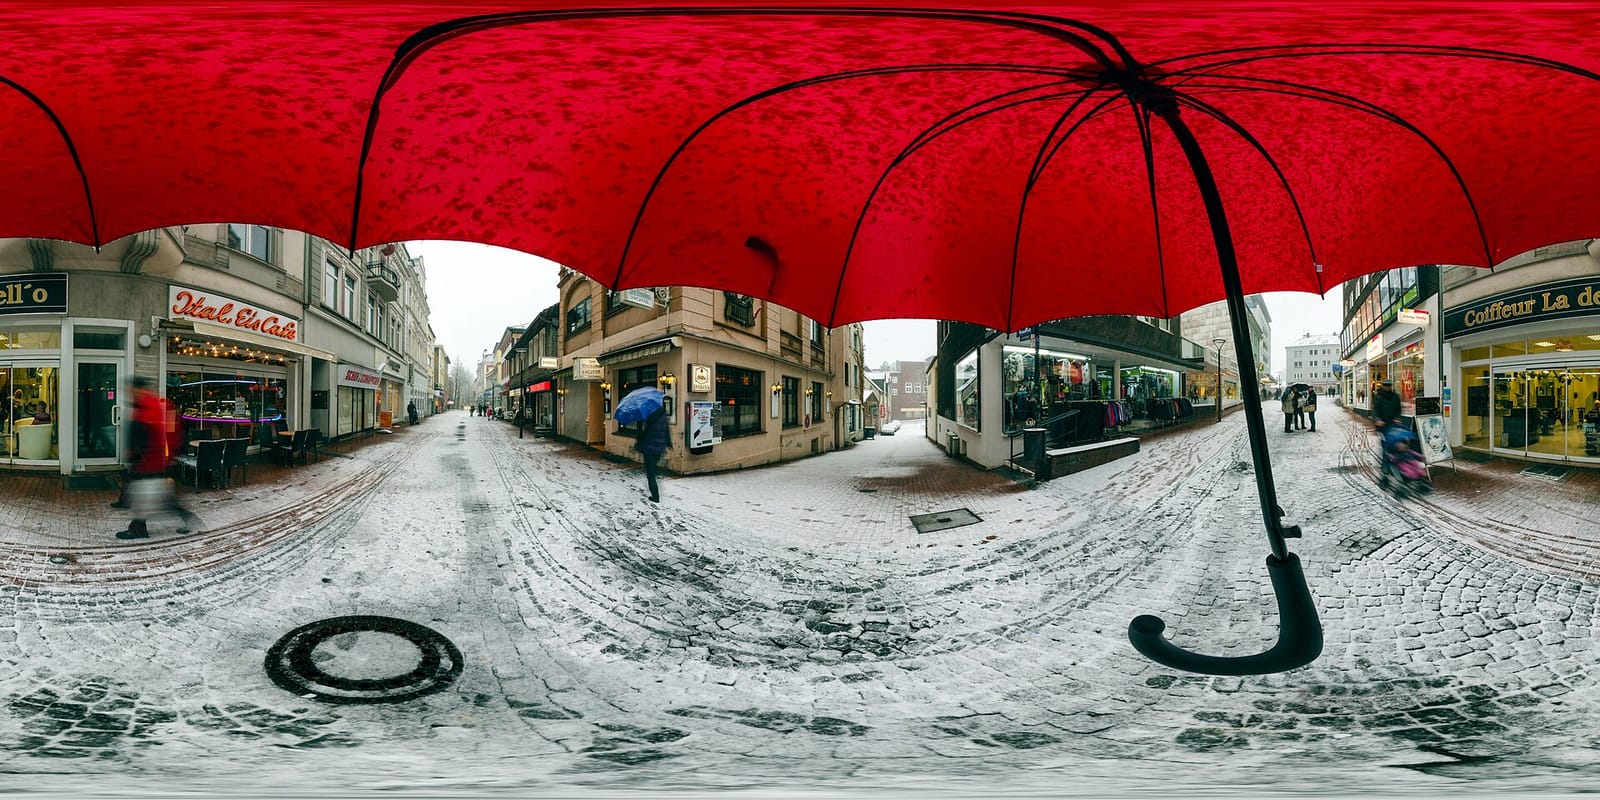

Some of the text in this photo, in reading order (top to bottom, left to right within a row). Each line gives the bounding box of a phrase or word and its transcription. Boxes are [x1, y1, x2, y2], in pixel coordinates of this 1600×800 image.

[234, 307, 260, 331] Eis
[1464, 301, 1536, 327] Coiffeur
[1542, 292, 1570, 311] La
